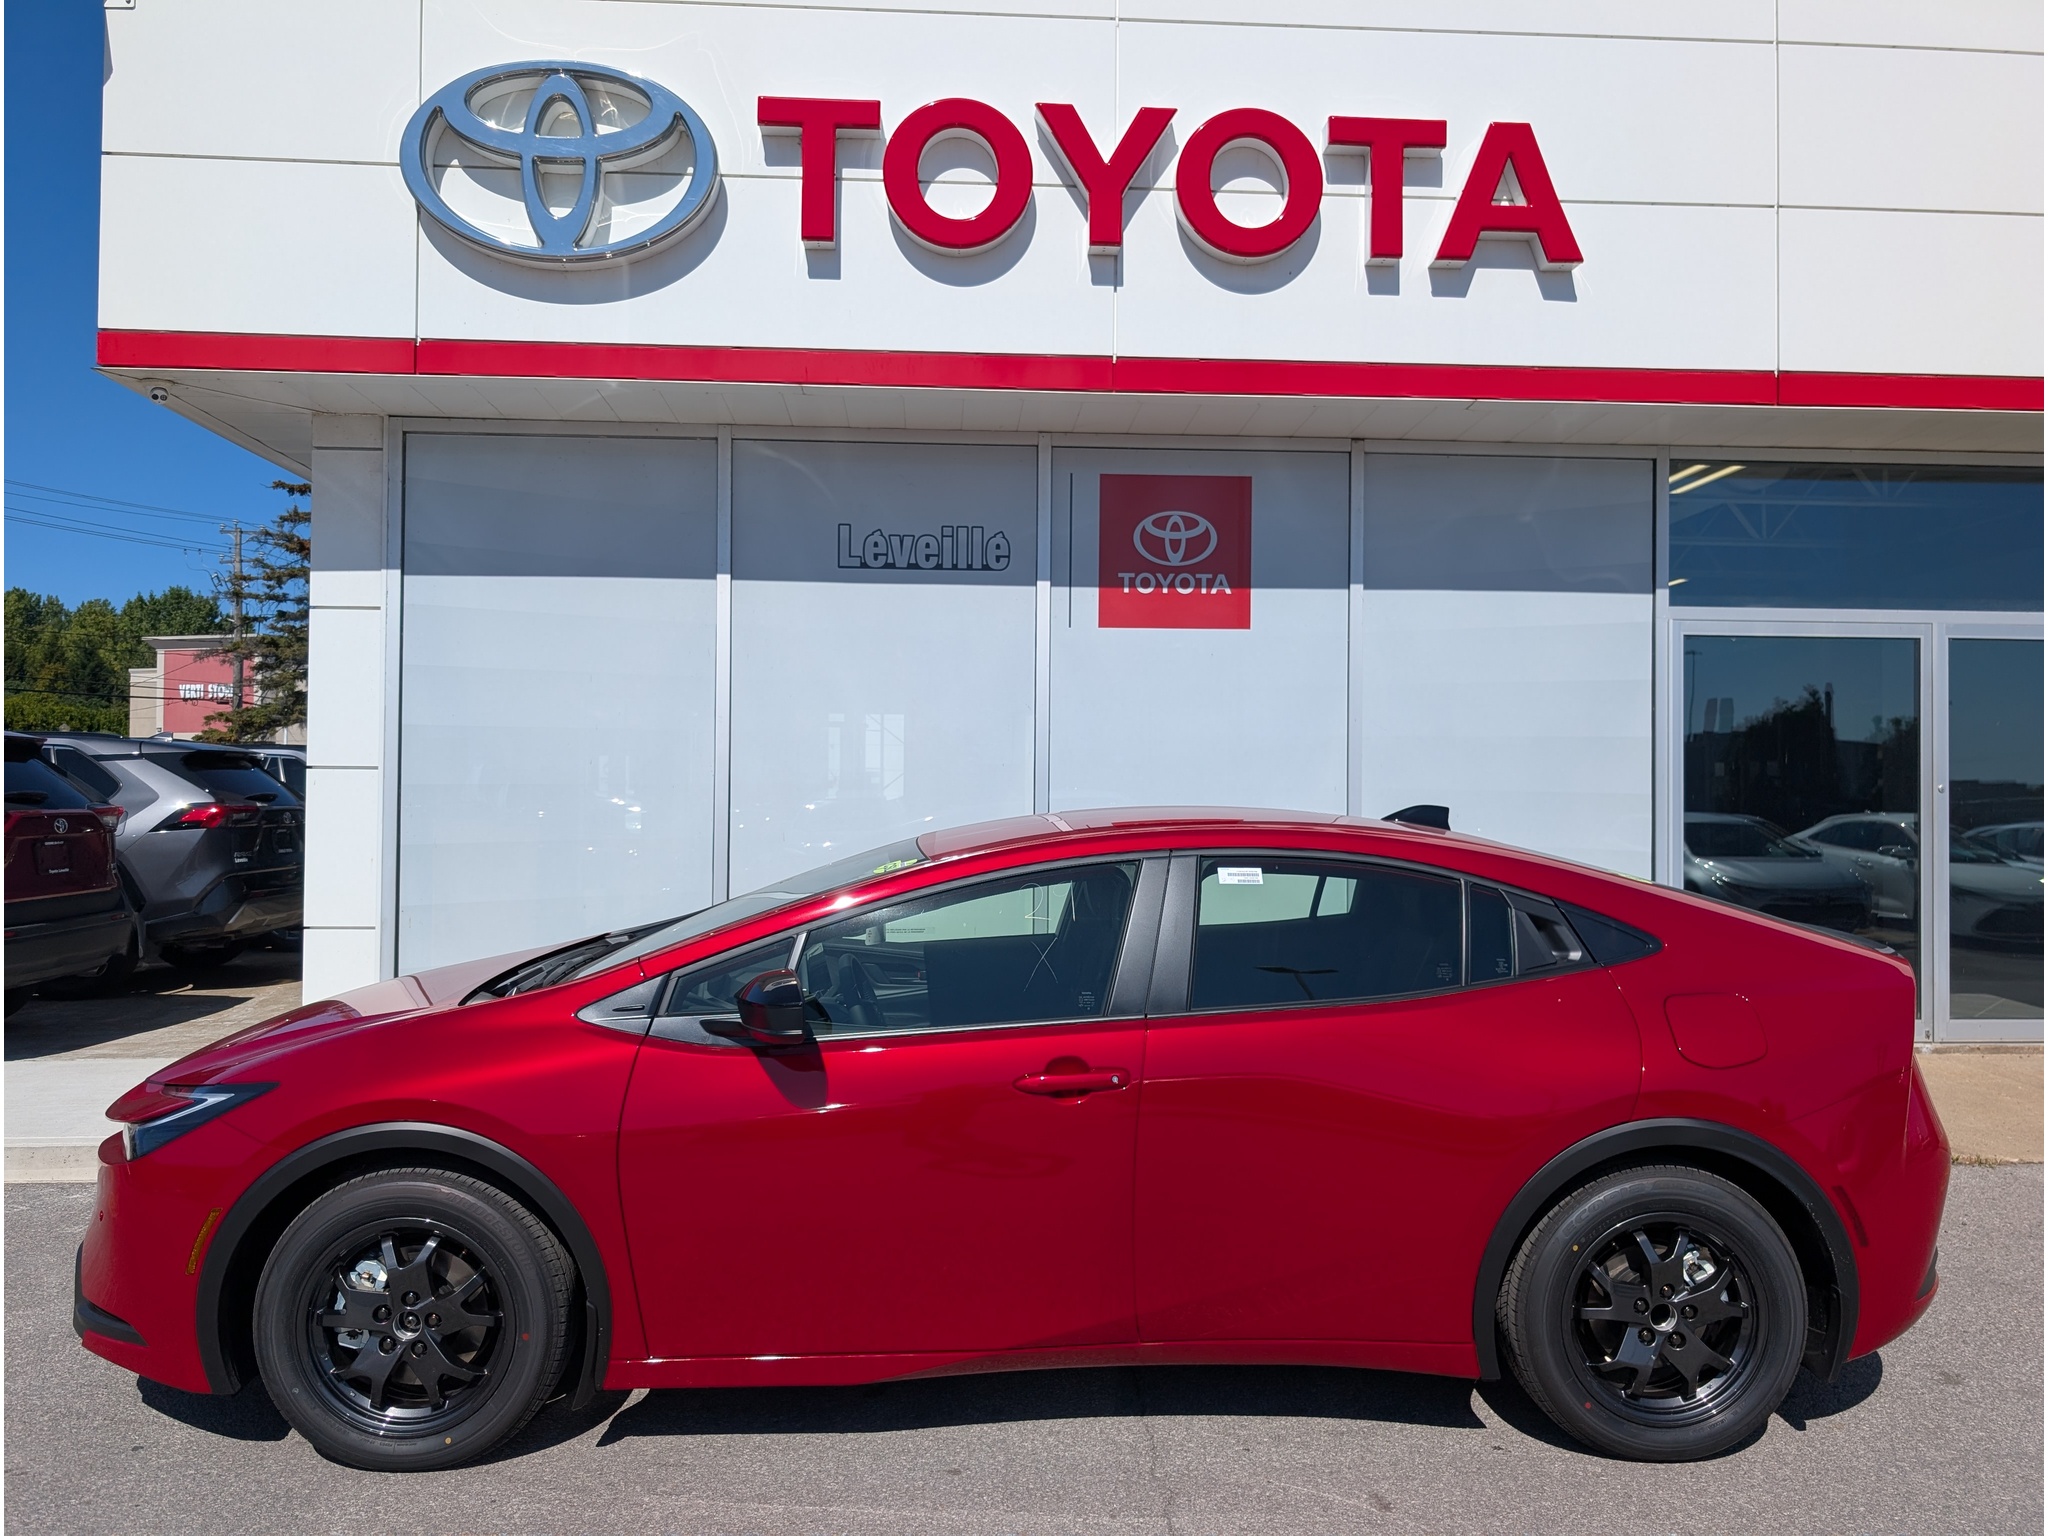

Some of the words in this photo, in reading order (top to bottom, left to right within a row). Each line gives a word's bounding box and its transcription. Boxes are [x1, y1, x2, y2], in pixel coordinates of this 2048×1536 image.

[757, 95, 1584, 265] TOYOTA
[838, 523, 1011, 571] Léveillé
[1117, 572, 1232, 595] TOYOTA
[179, 684, 204, 698] VERTI
